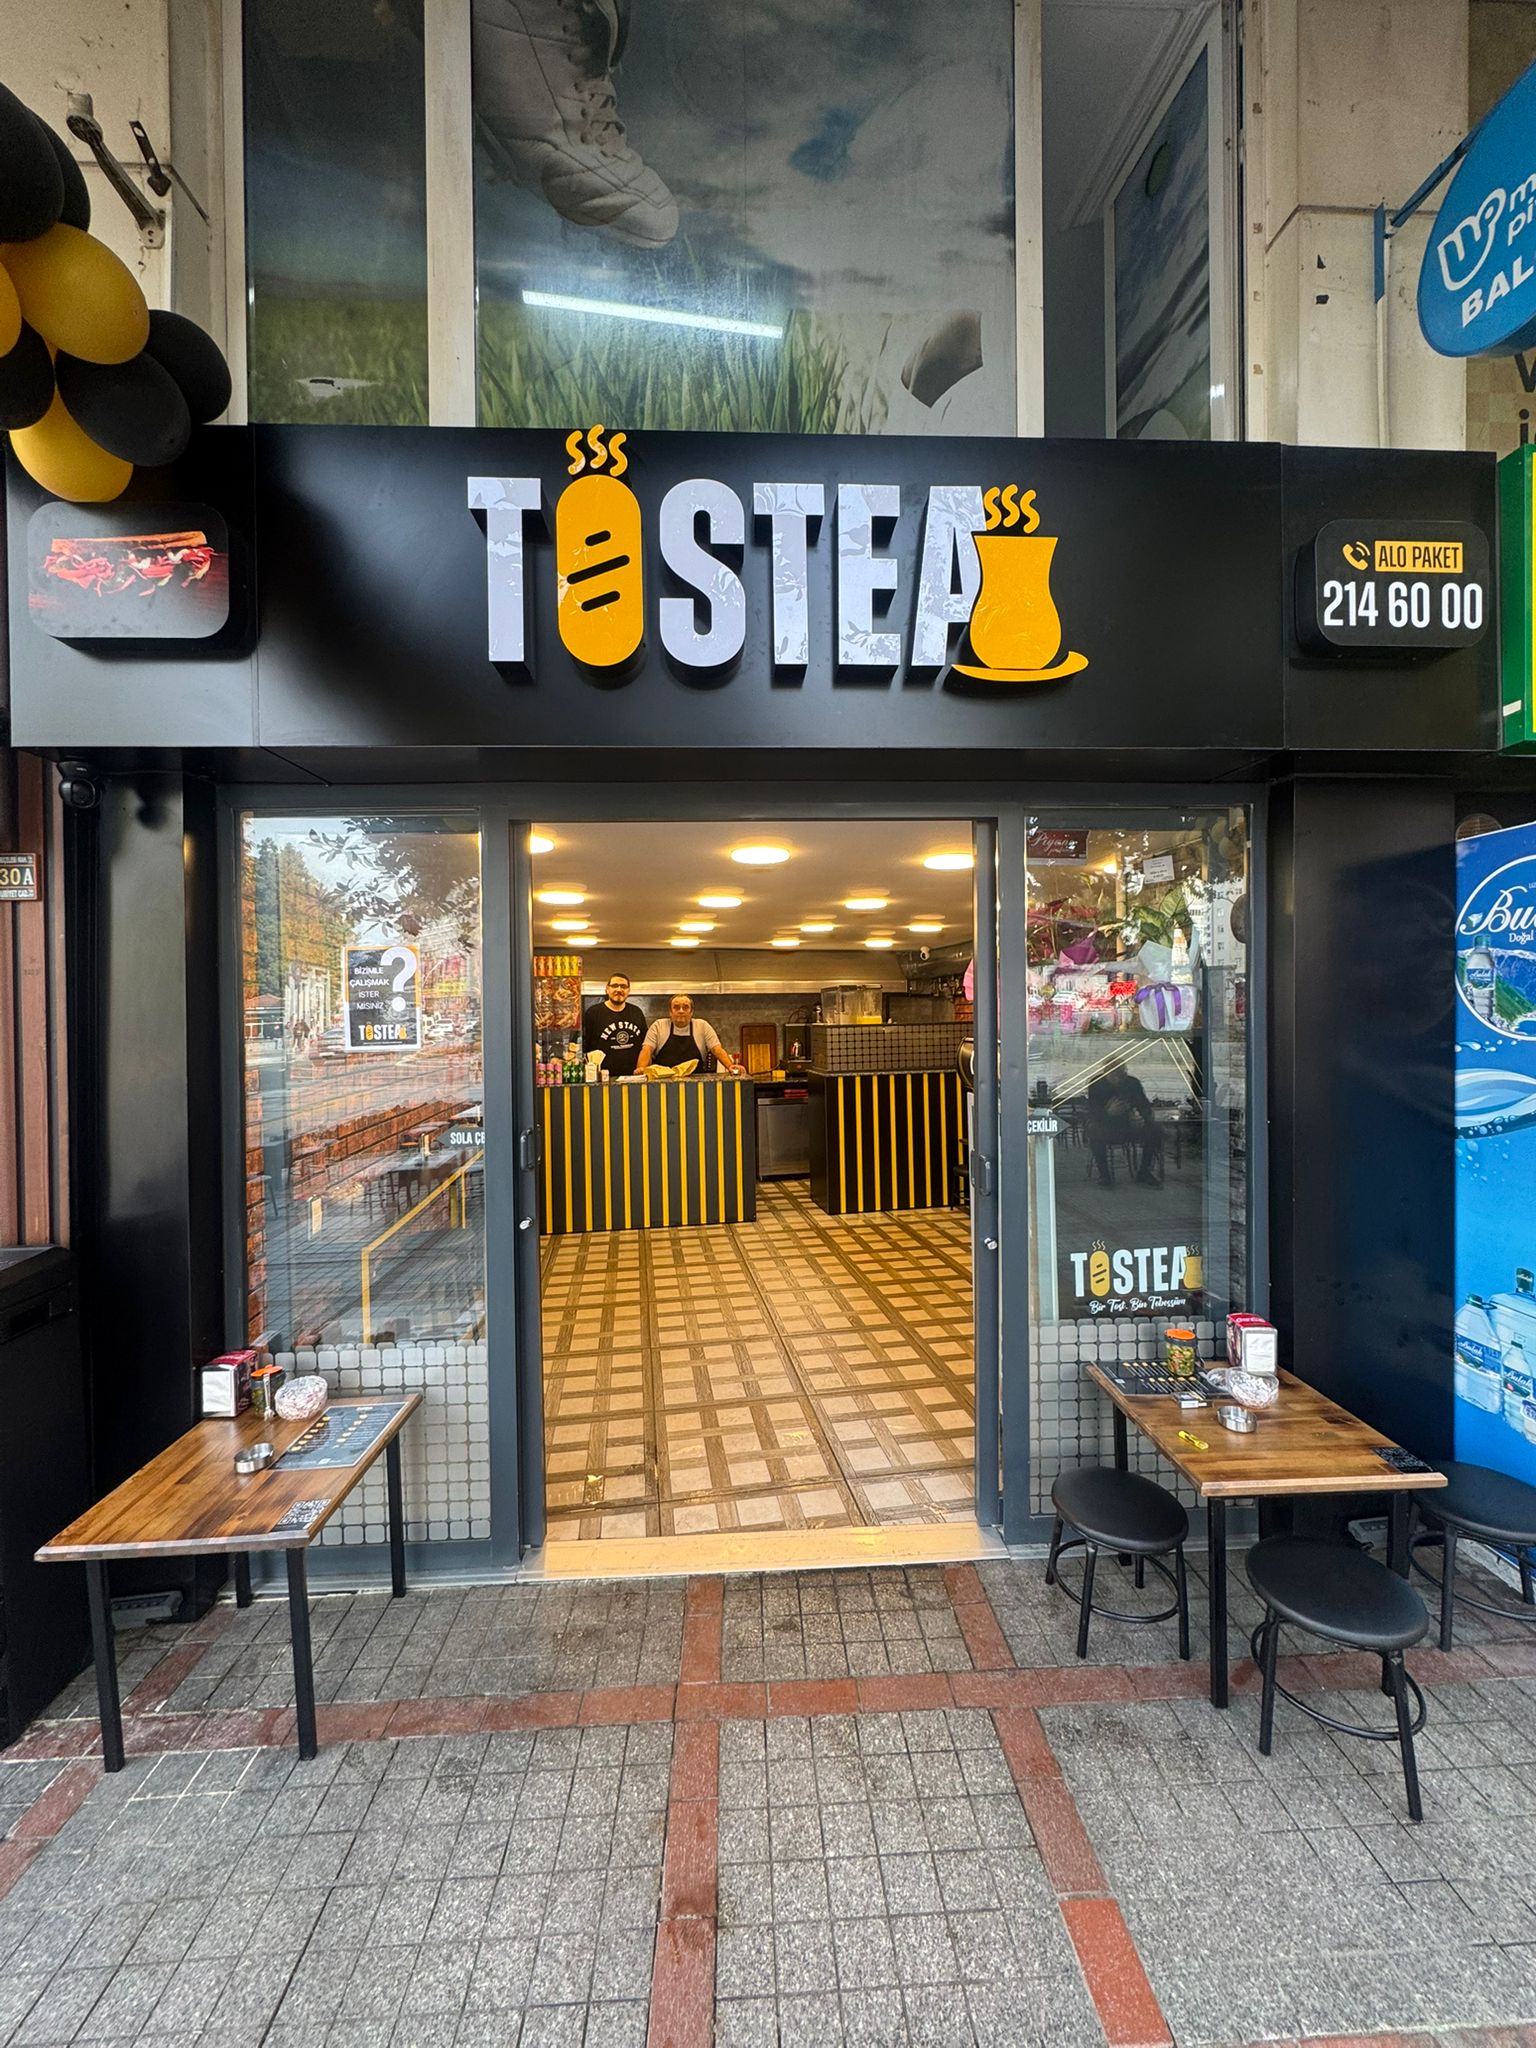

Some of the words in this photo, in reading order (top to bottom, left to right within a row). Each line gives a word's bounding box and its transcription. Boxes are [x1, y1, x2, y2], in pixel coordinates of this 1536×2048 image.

[1507, 196, 1536, 247] pi
[1378, 545, 1407, 568] ALO
[1412, 546, 1460, 569] PAKET
[467, 474, 988, 667] TOSTEA
[1323, 580, 1379, 627] 214
[1388, 581, 1431, 629] 60
[1441, 582, 1483, 630] 00
[1460, 886, 1536, 933] Bu
[1509, 930, 1534, 945] Doğal
[349, 979, 390, 988] ÇALIŞMAK
[358, 1023, 403, 1041] TOSTEA
[600, 1022, 617, 1040] NEW
[1027, 1117, 1058, 1134] ÇEKİLİR
[450, 1131, 473, 1145] SOLA
[1070, 1246, 1187, 1298] TOSTEA
[1089, 1300, 1106, 1314] Bir
[1129, 1297, 1148, 1311] Bin
